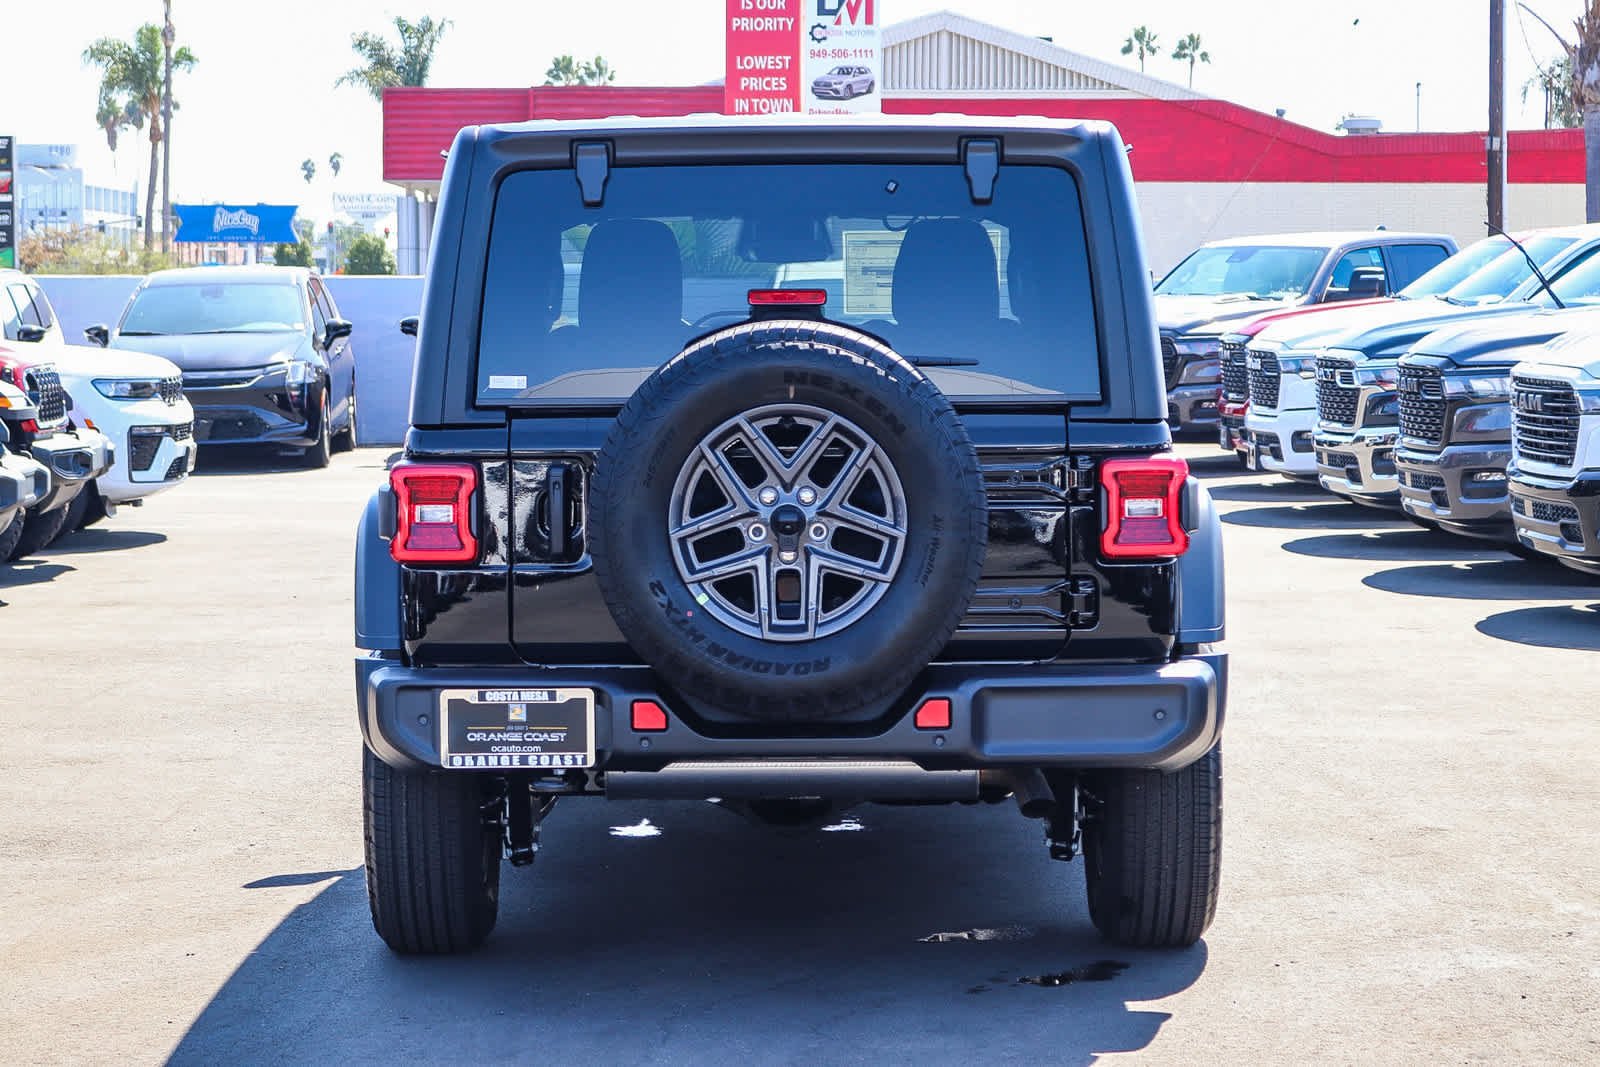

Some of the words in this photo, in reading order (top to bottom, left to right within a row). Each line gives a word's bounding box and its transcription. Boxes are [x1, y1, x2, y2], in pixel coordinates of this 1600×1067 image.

[741, 0, 751, 10] IS
[752, 0, 786, 10] OUR
[732, 17, 794, 31] PRIORITY
[810, 49, 874, 58] 949-506-1111
[736, 56, 791, 70] LOWEST
[740, 77, 787, 91] PRICES
[735, 98, 749, 113] IN
[753, 98, 793, 113] TOWN
[485, 691, 519, 701] COSTA
[521, 691, 549, 701] MESA
[466, 732, 523, 742] ORANGE
[523, 732, 567, 742] COAST
[491, 745, 541, 753] ocauto.com
[452, 756, 521, 766] ORANGE
[527, 755, 585, 766] COAST
